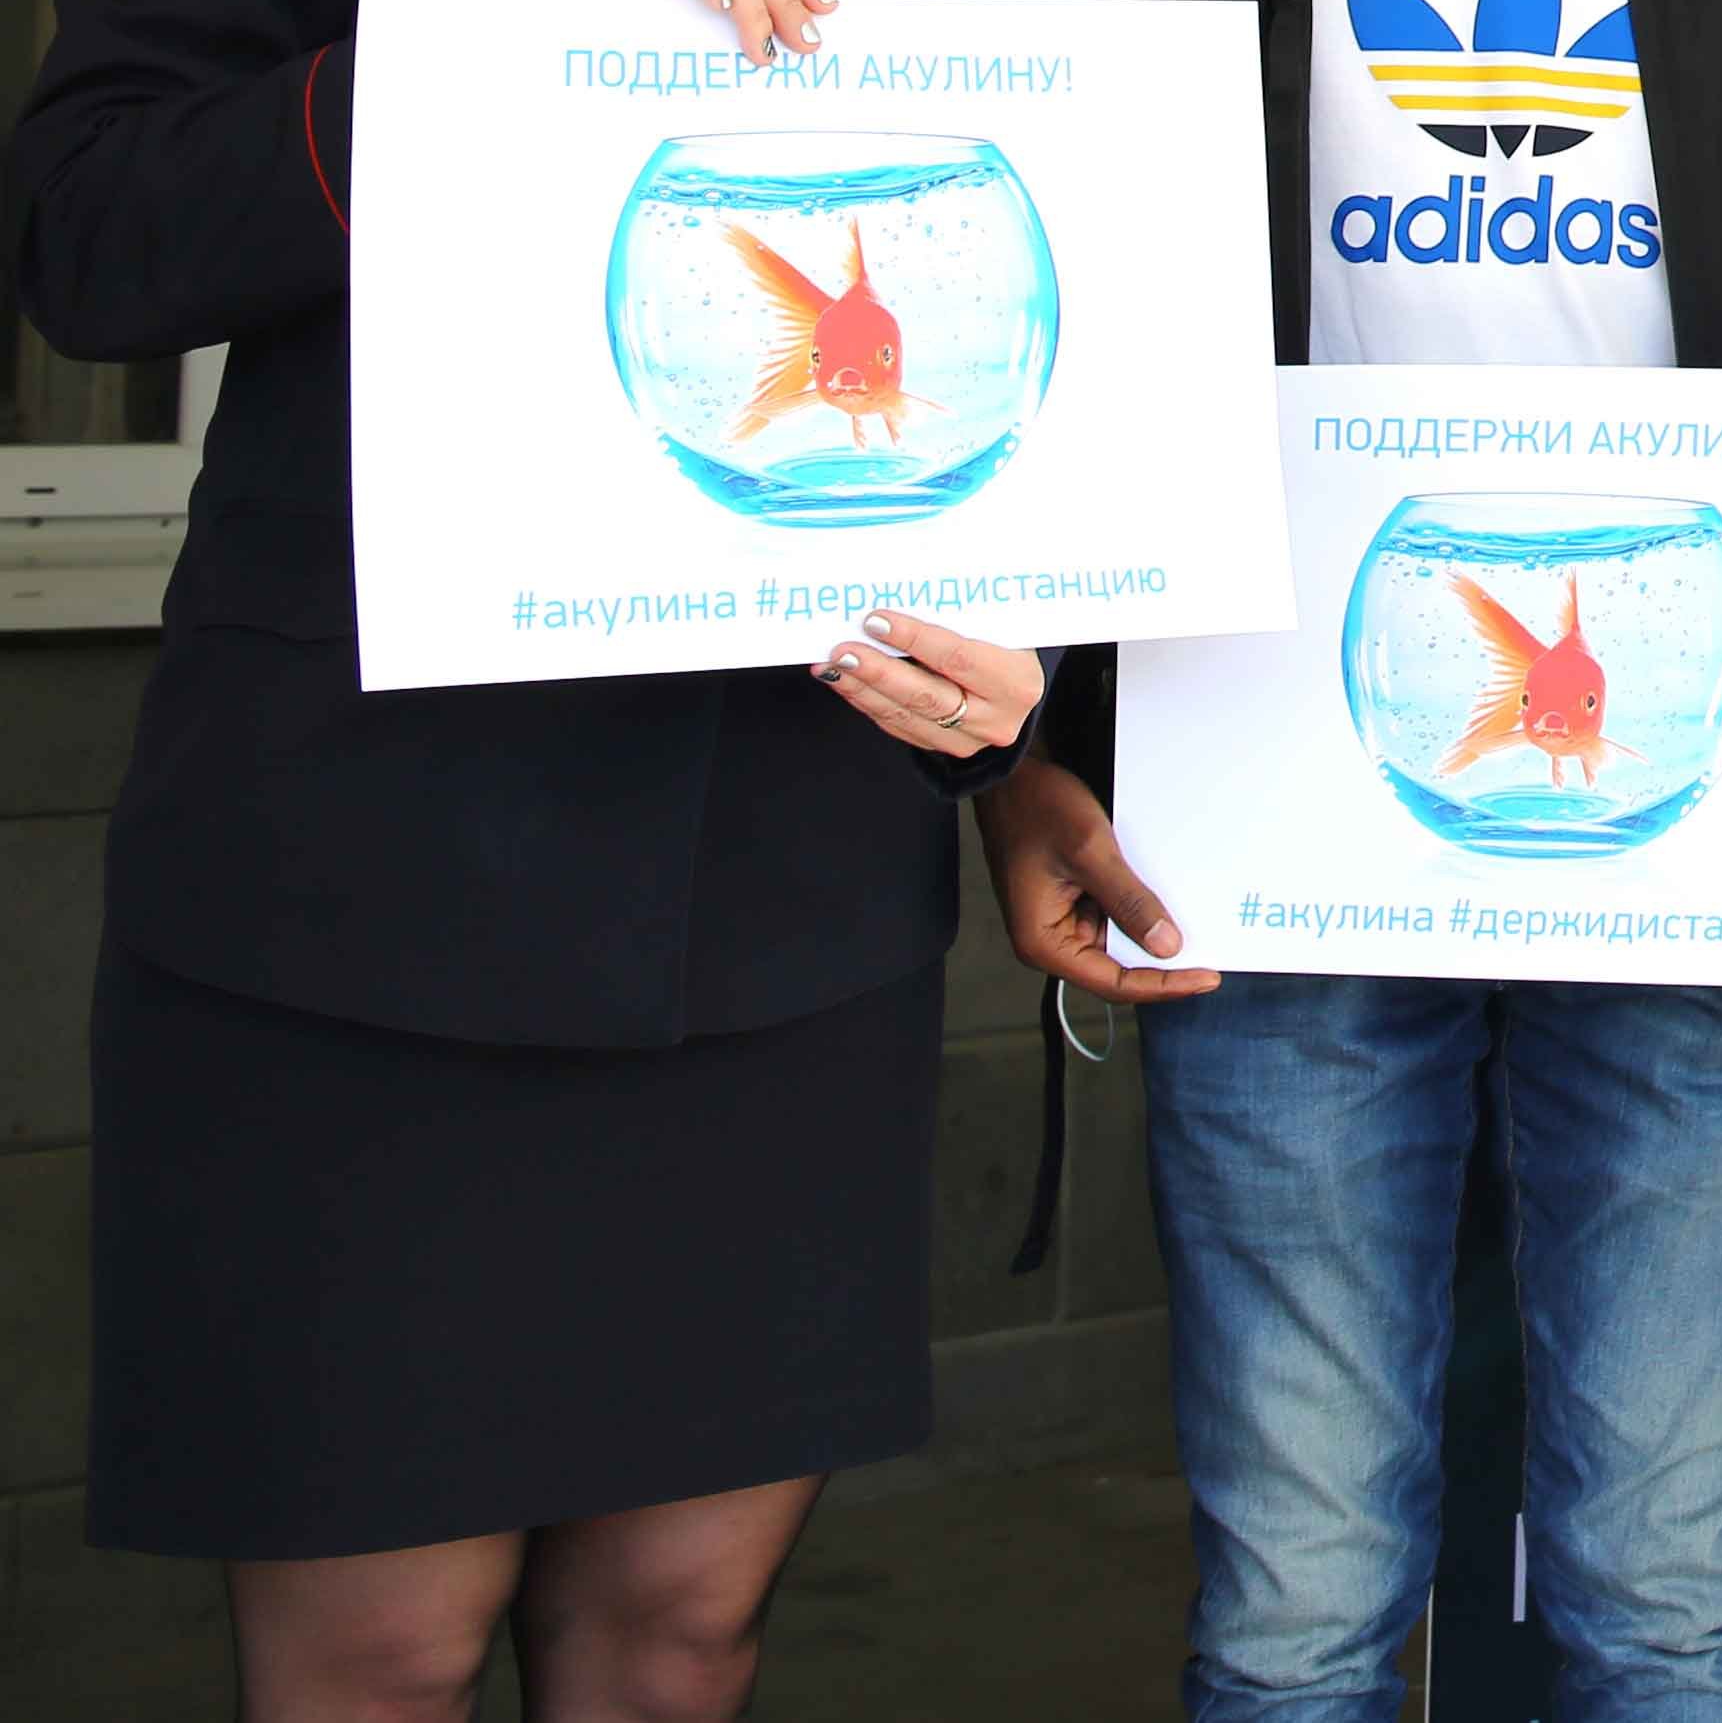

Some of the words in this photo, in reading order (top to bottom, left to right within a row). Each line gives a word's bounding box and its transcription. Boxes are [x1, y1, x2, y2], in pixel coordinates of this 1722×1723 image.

[564, 47, 842, 96] ПОДДЕРЖИ
[858, 53, 1074, 93] АКУЛИНУ!
[1330, 174, 1662, 269] adidas
[1313, 416, 1573, 459] ПОДДЕРЖИ
[511, 589, 738, 637] #акулина
[753, 565, 1168, 623] #держидистанцию
[1239, 892, 1434, 940] #акулина
